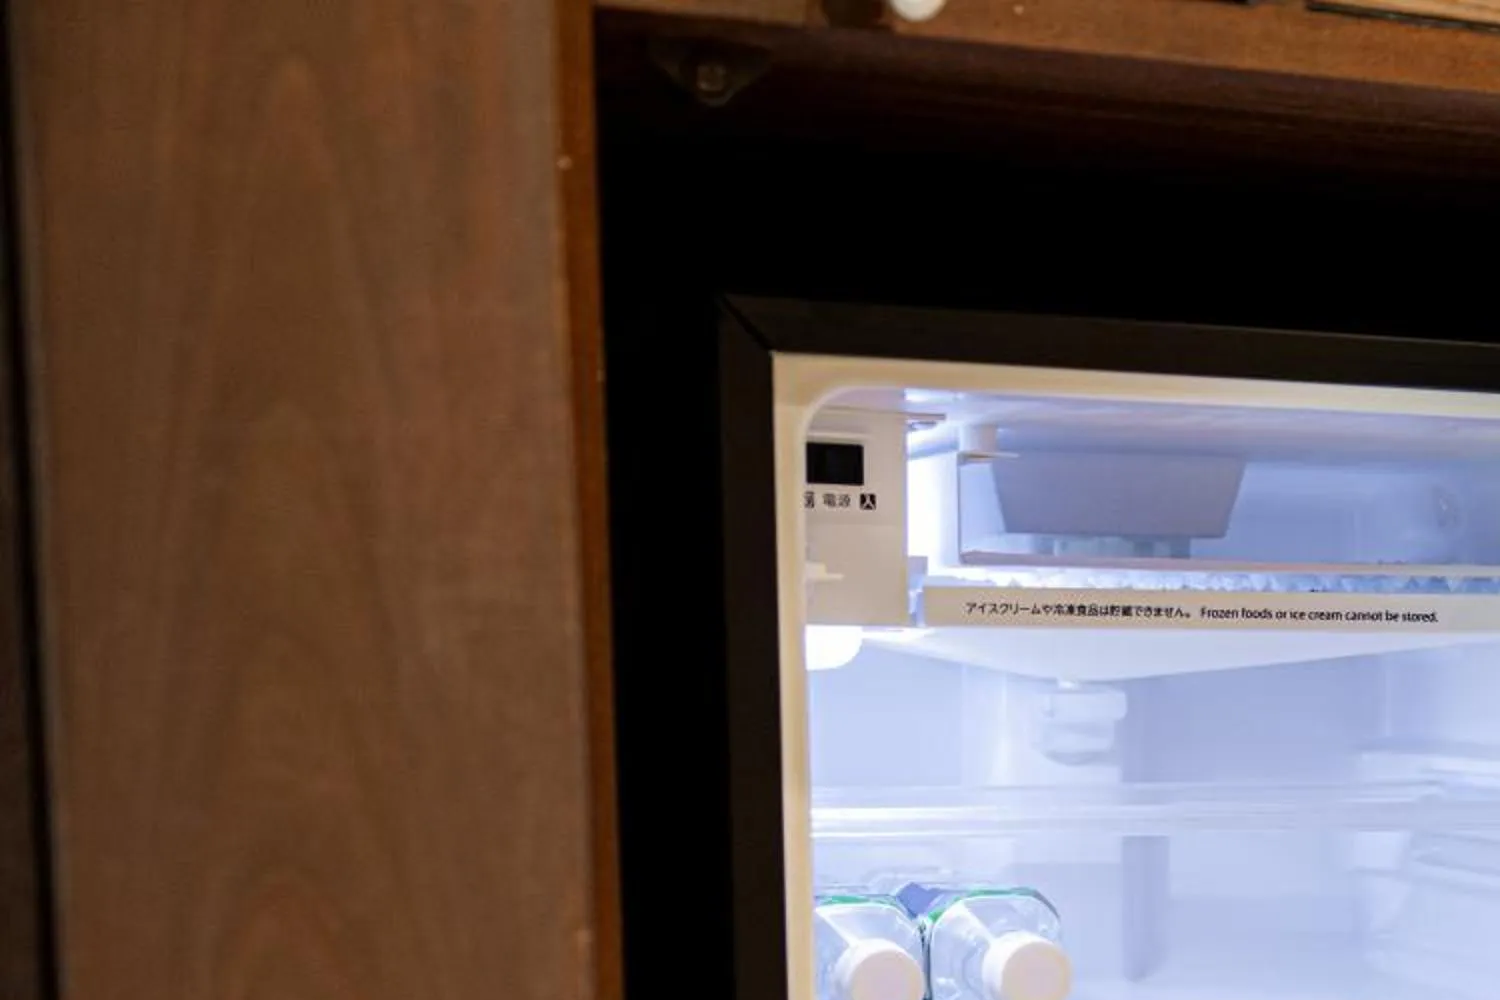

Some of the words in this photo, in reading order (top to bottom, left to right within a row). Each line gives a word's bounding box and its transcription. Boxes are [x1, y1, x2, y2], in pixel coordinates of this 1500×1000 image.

[1200, 606, 1239, 620] Frozen
[1241, 606, 1273, 621] foods
[1275, 610, 1288, 621] or
[1289, 608, 1305, 621] ice
[1307, 610, 1343, 622] cream
[1345, 609, 1383, 623] cannot
[1385, 609, 1399, 623] be
[1401, 610, 1439, 624] stored.
